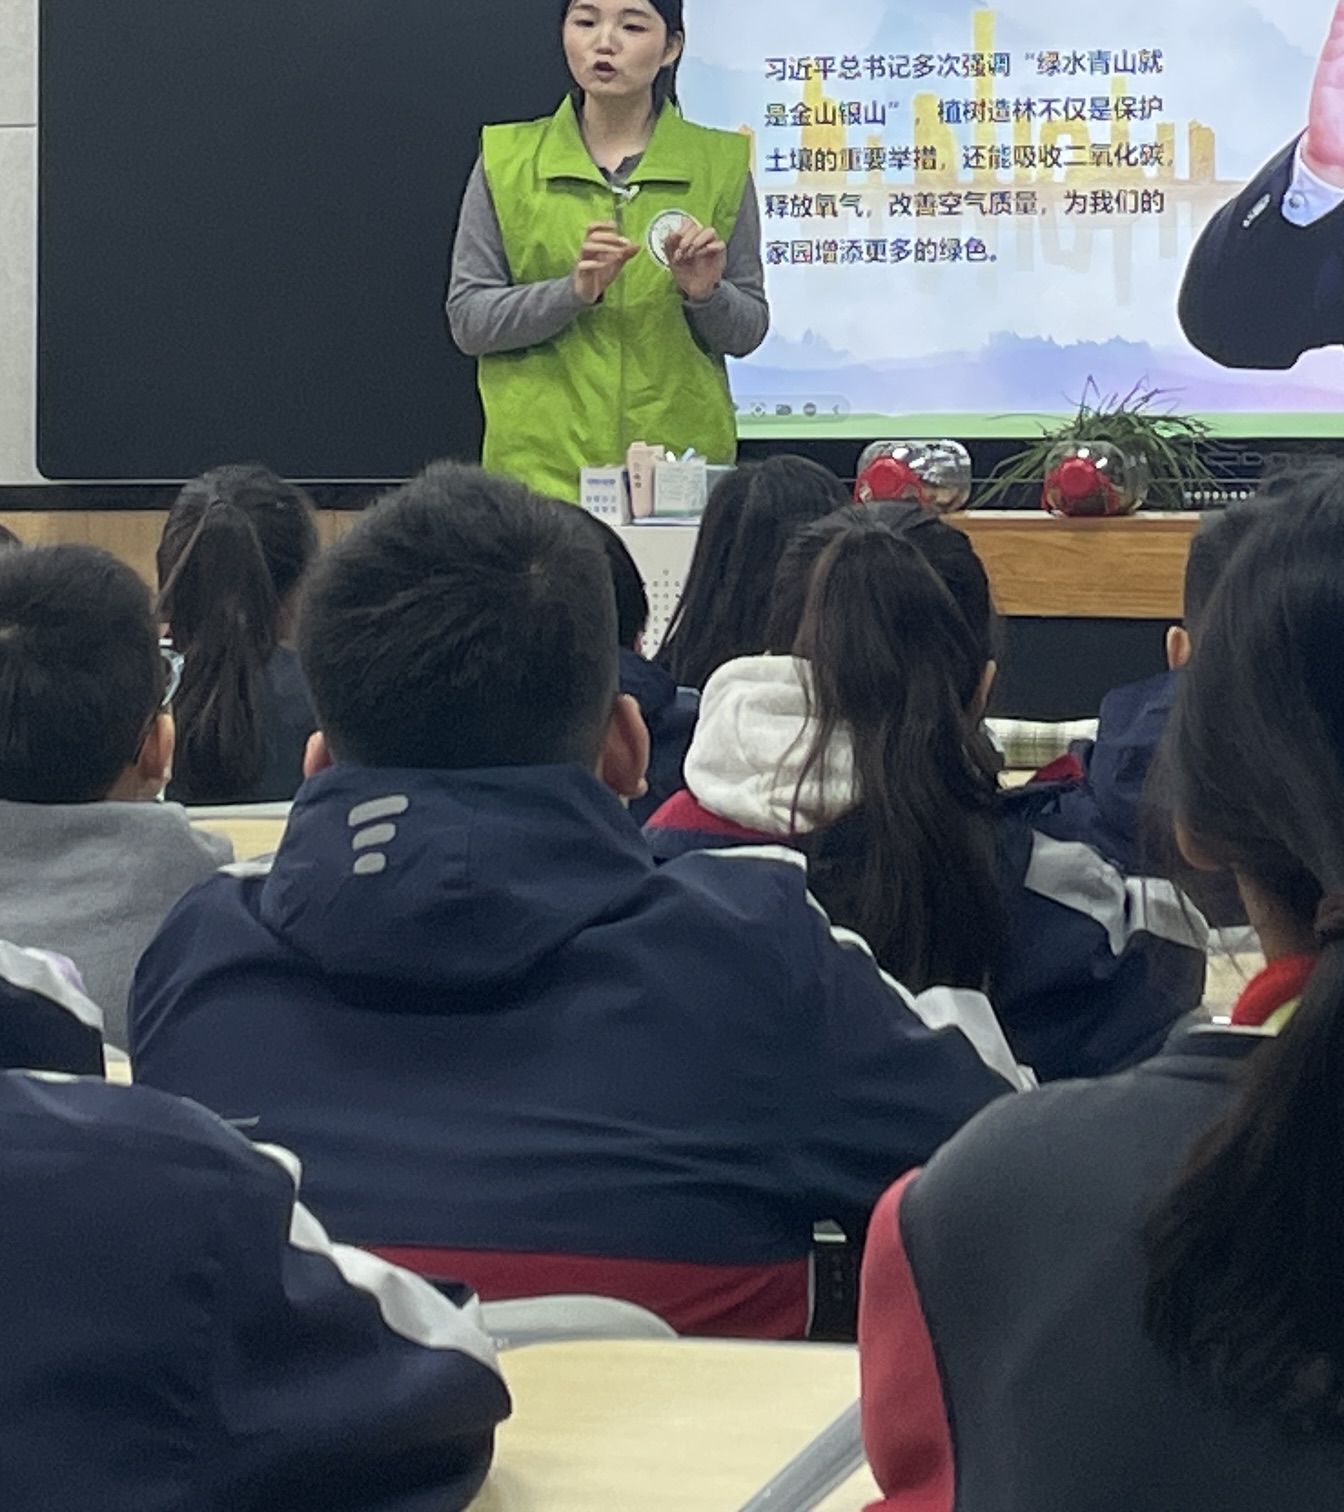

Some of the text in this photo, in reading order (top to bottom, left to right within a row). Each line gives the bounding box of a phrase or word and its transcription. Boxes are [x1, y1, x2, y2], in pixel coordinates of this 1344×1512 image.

[765, 237, 998, 265] 家园增添更多的绿色。
